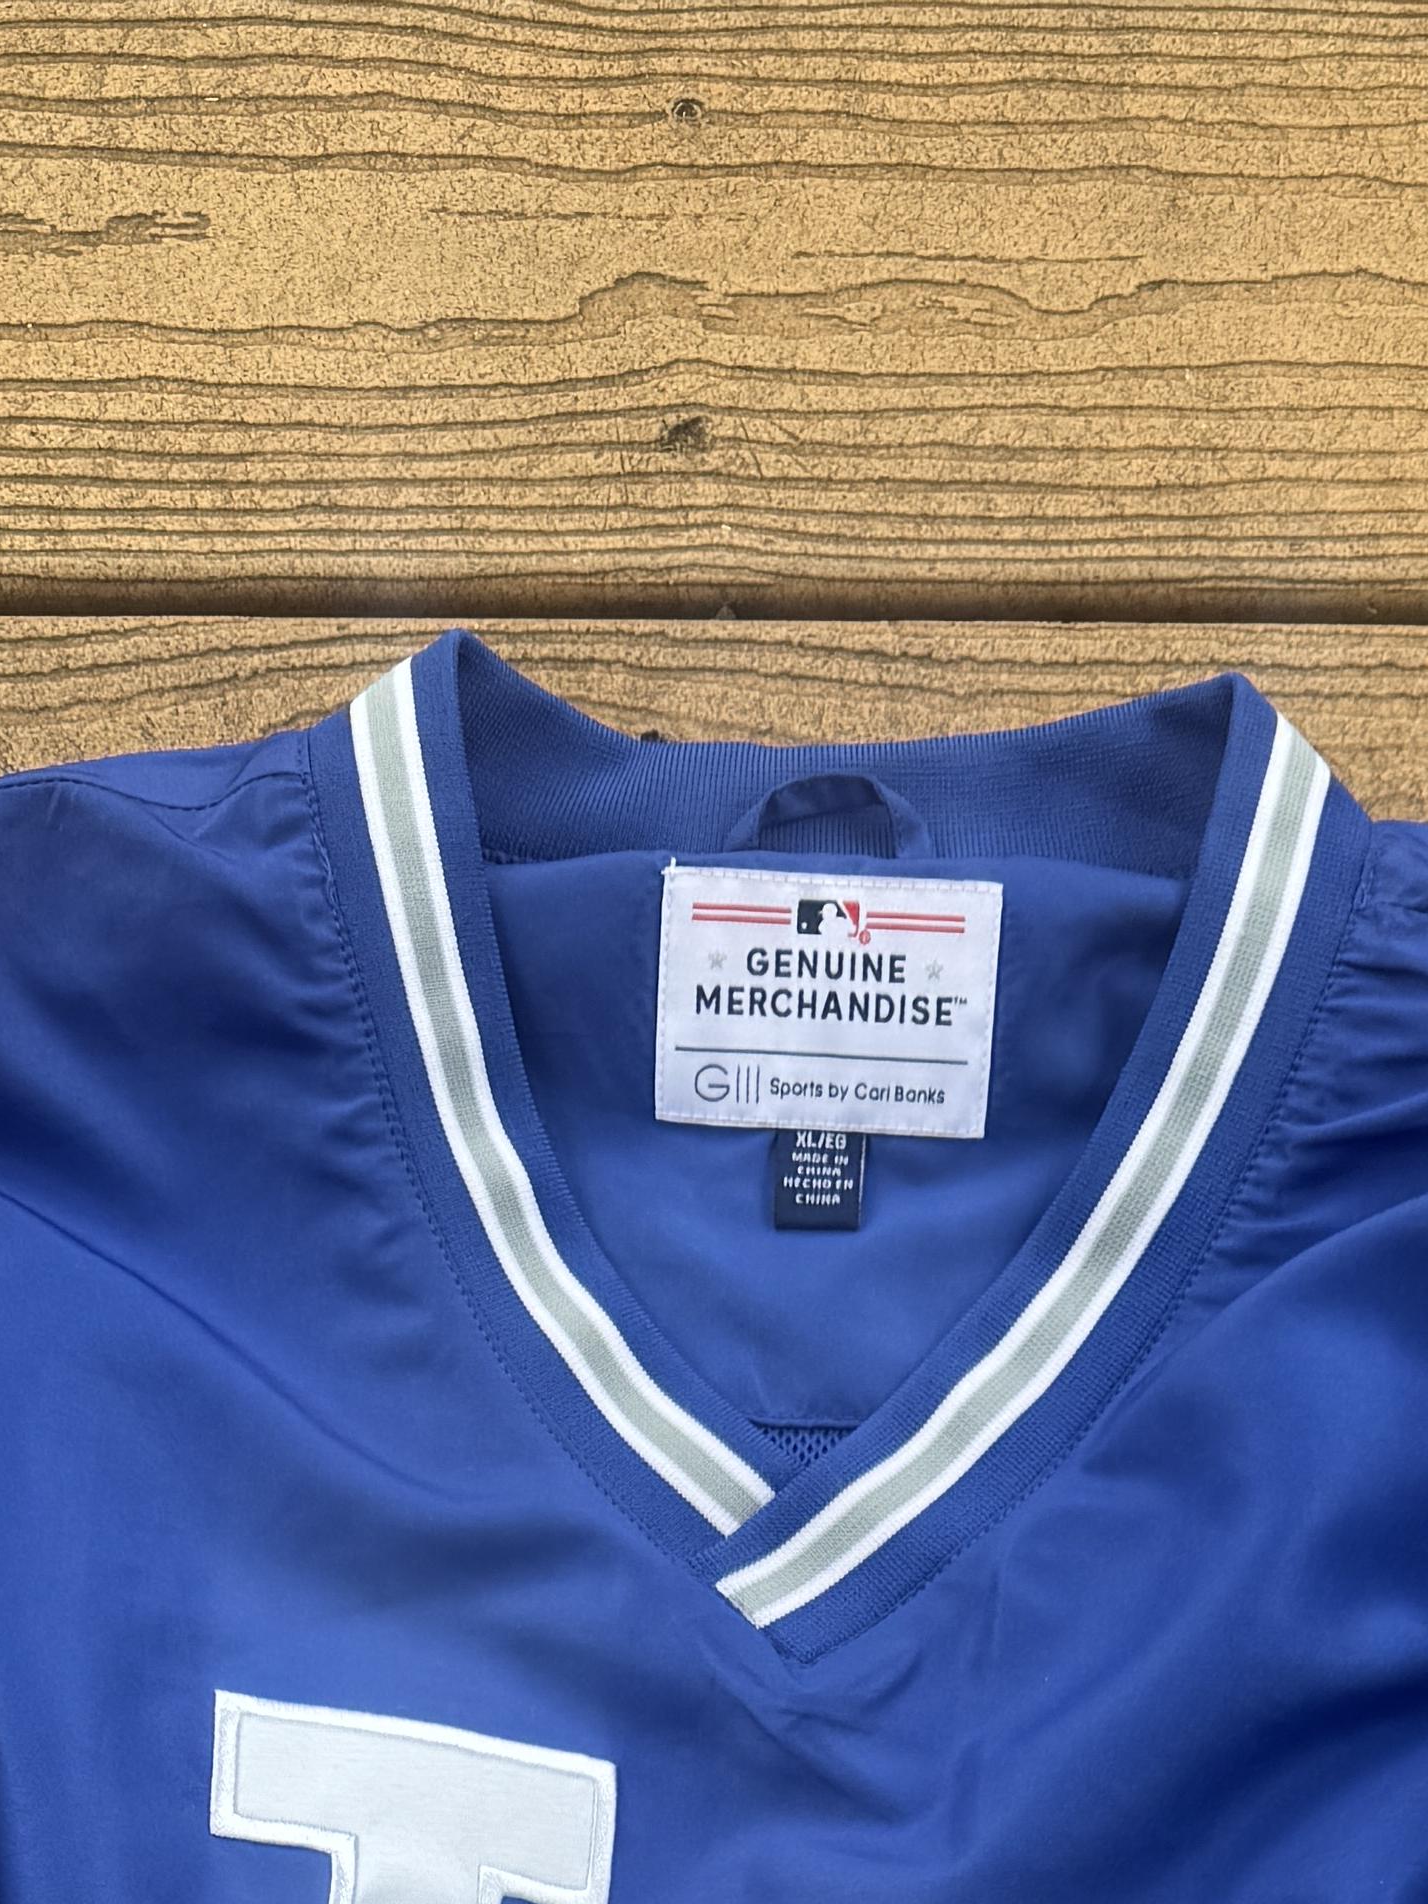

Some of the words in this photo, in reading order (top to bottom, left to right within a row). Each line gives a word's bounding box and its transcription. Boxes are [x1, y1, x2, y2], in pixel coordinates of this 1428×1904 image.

[746, 947, 907, 984] GENUINE
[770, 1076, 823, 1099] Sports
[828, 1080, 848, 1102] by
[854, 1083, 890, 1102] Carl
[895, 1085, 946, 1105] Banks
[792, 1152, 828, 1164] MADE
[834, 1155, 848, 1166] IN
[797, 1165, 842, 1177] CHINA
[783, 1176, 832, 1189] HECHO
[836, 1179, 854, 1190] EN
[795, 1193, 841, 1206] CHINA
